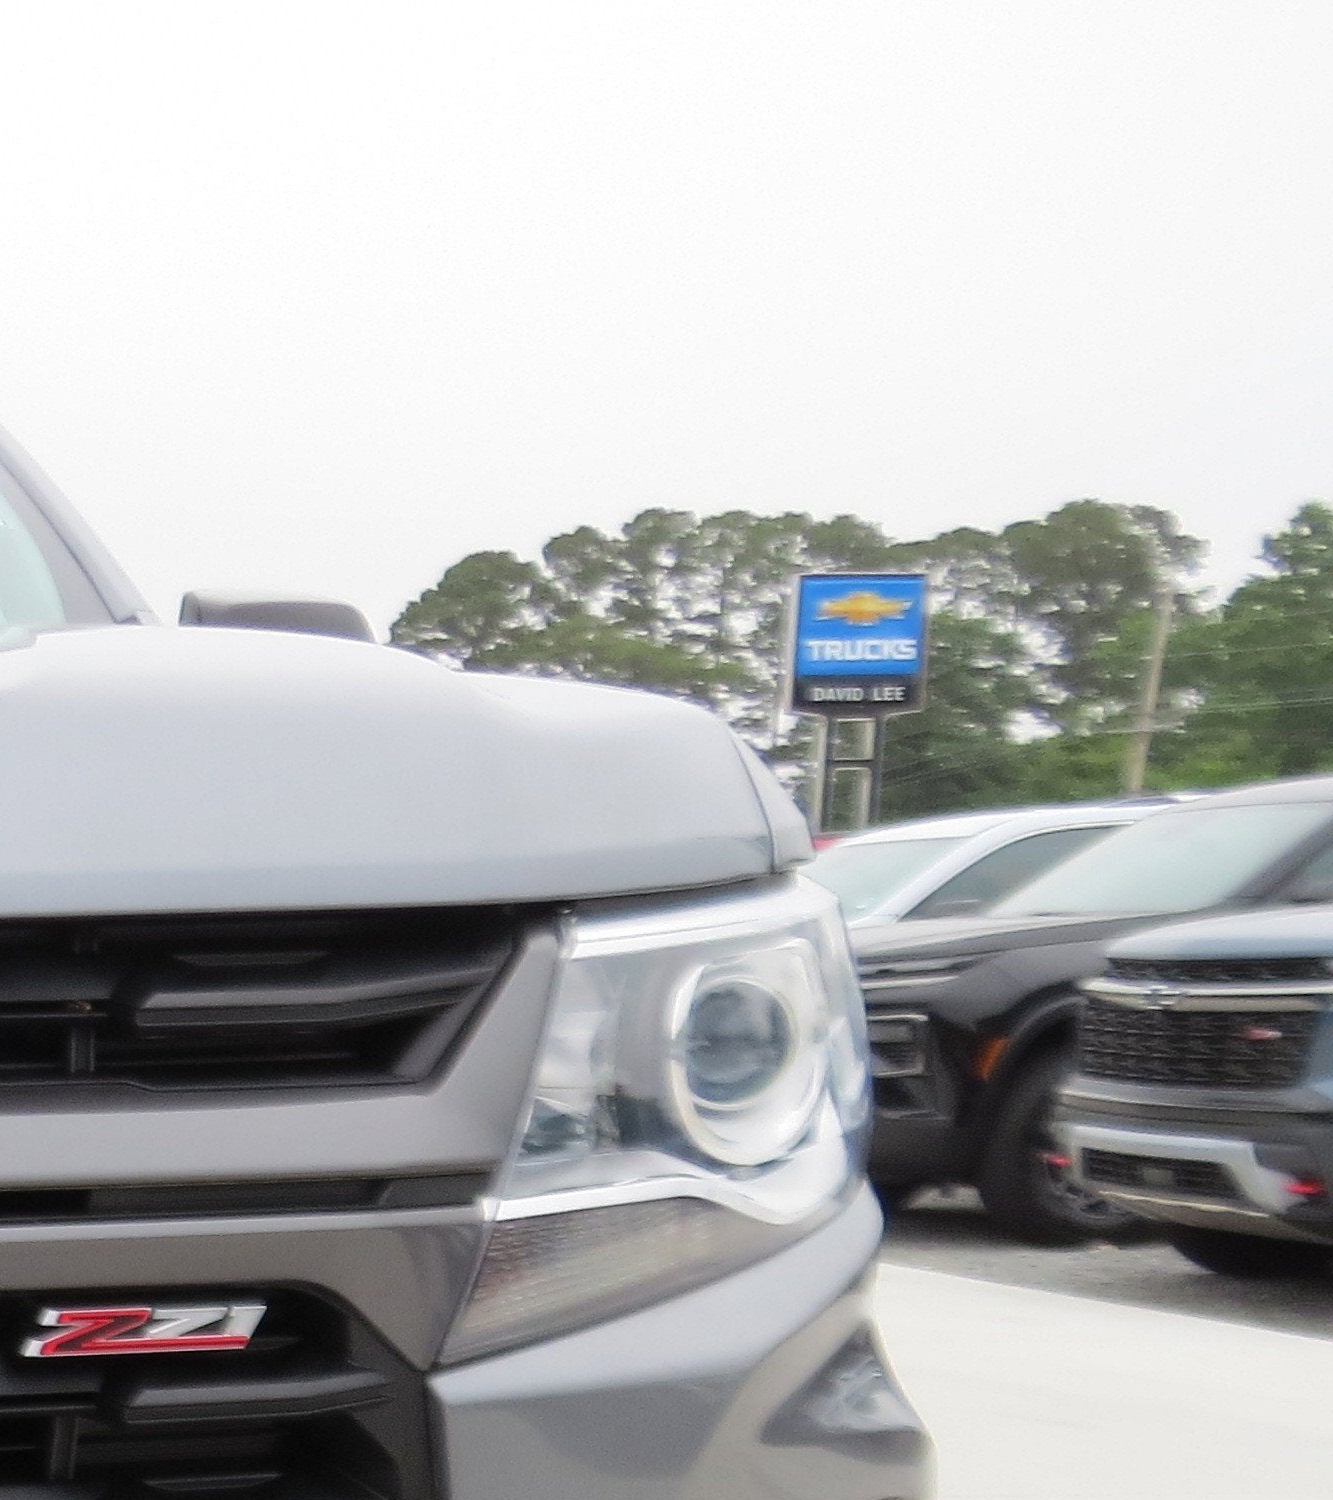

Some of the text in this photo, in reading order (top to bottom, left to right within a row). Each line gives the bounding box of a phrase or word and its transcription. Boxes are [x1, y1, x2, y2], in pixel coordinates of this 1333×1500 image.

[805, 638, 918, 661] TRUCKS
[812, 686, 906, 702] DAVID LEE
[22, 1305, 268, 1357] Z71
